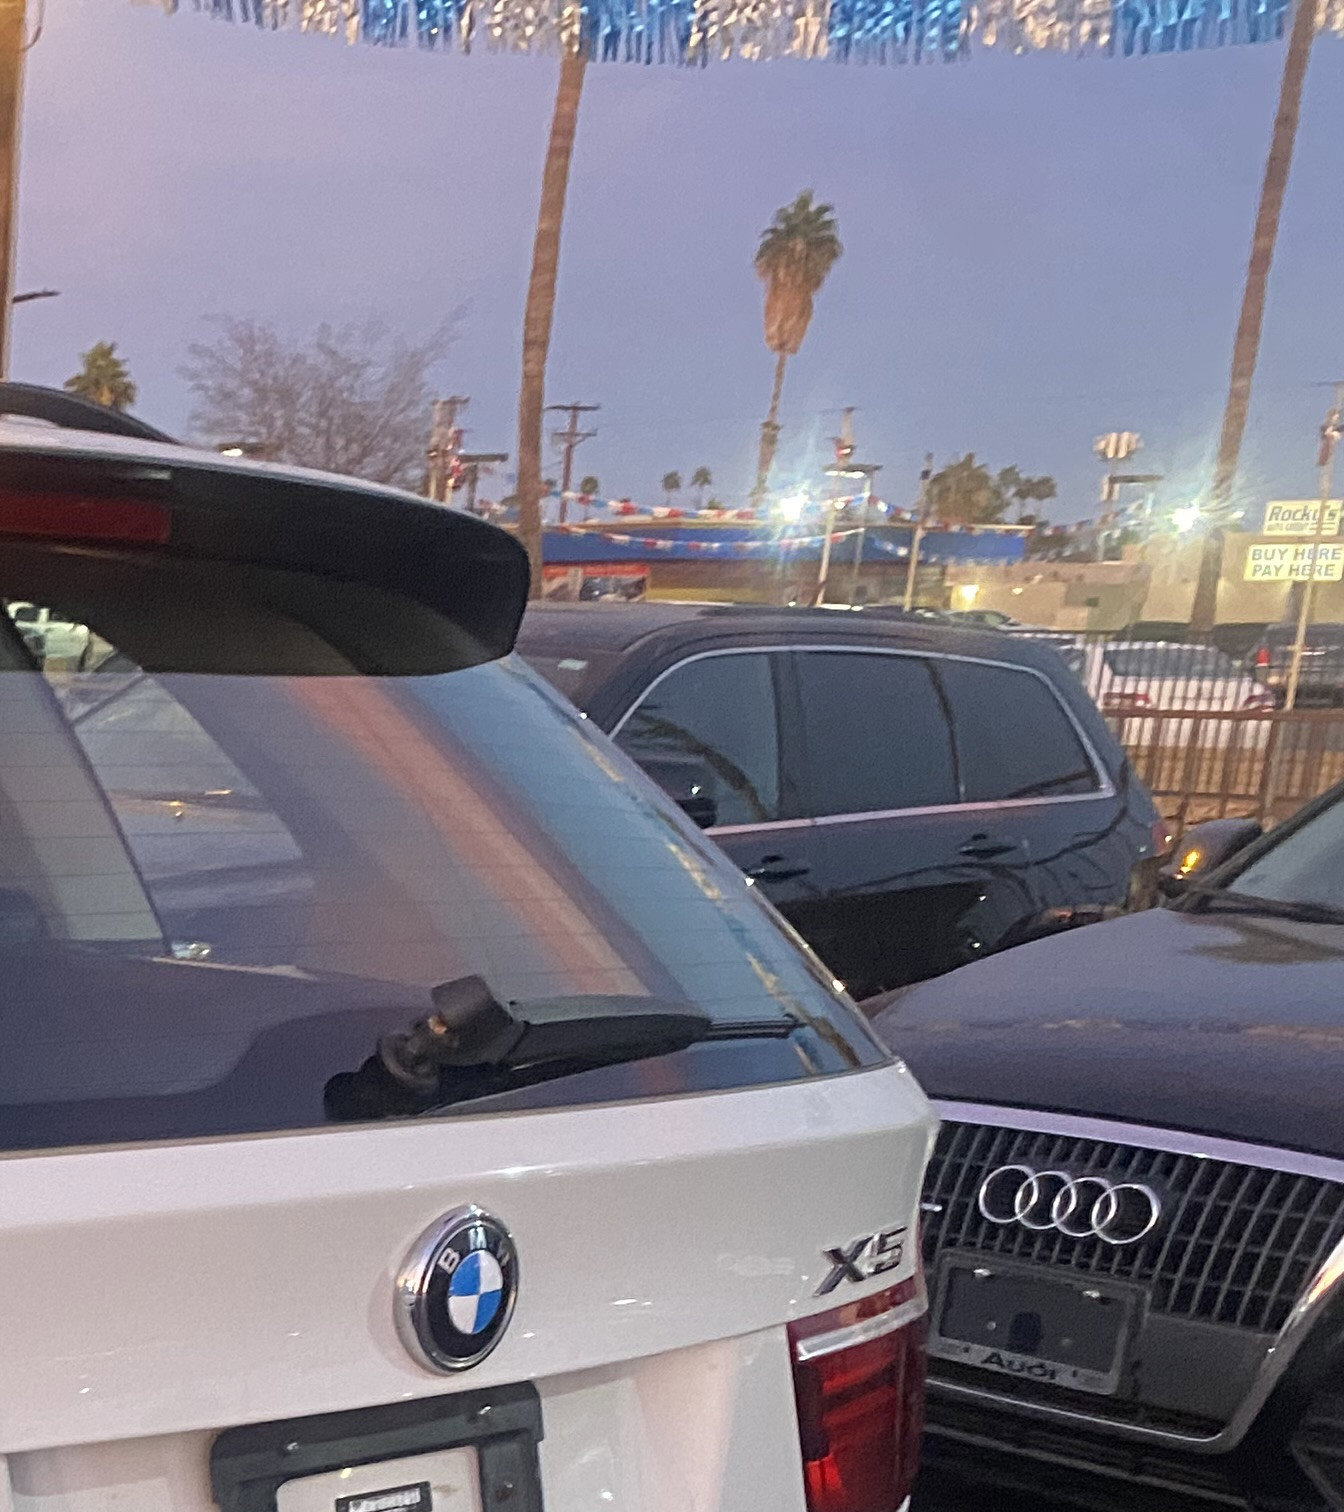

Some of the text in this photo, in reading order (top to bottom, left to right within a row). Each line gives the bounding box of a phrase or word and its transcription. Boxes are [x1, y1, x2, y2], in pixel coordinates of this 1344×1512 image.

[1251, 548, 1288, 561] BUY
[1251, 564, 1284, 577] PAY
[813, 1225, 908, 1297] X5
[981, 1351, 1057, 1380] Audi
